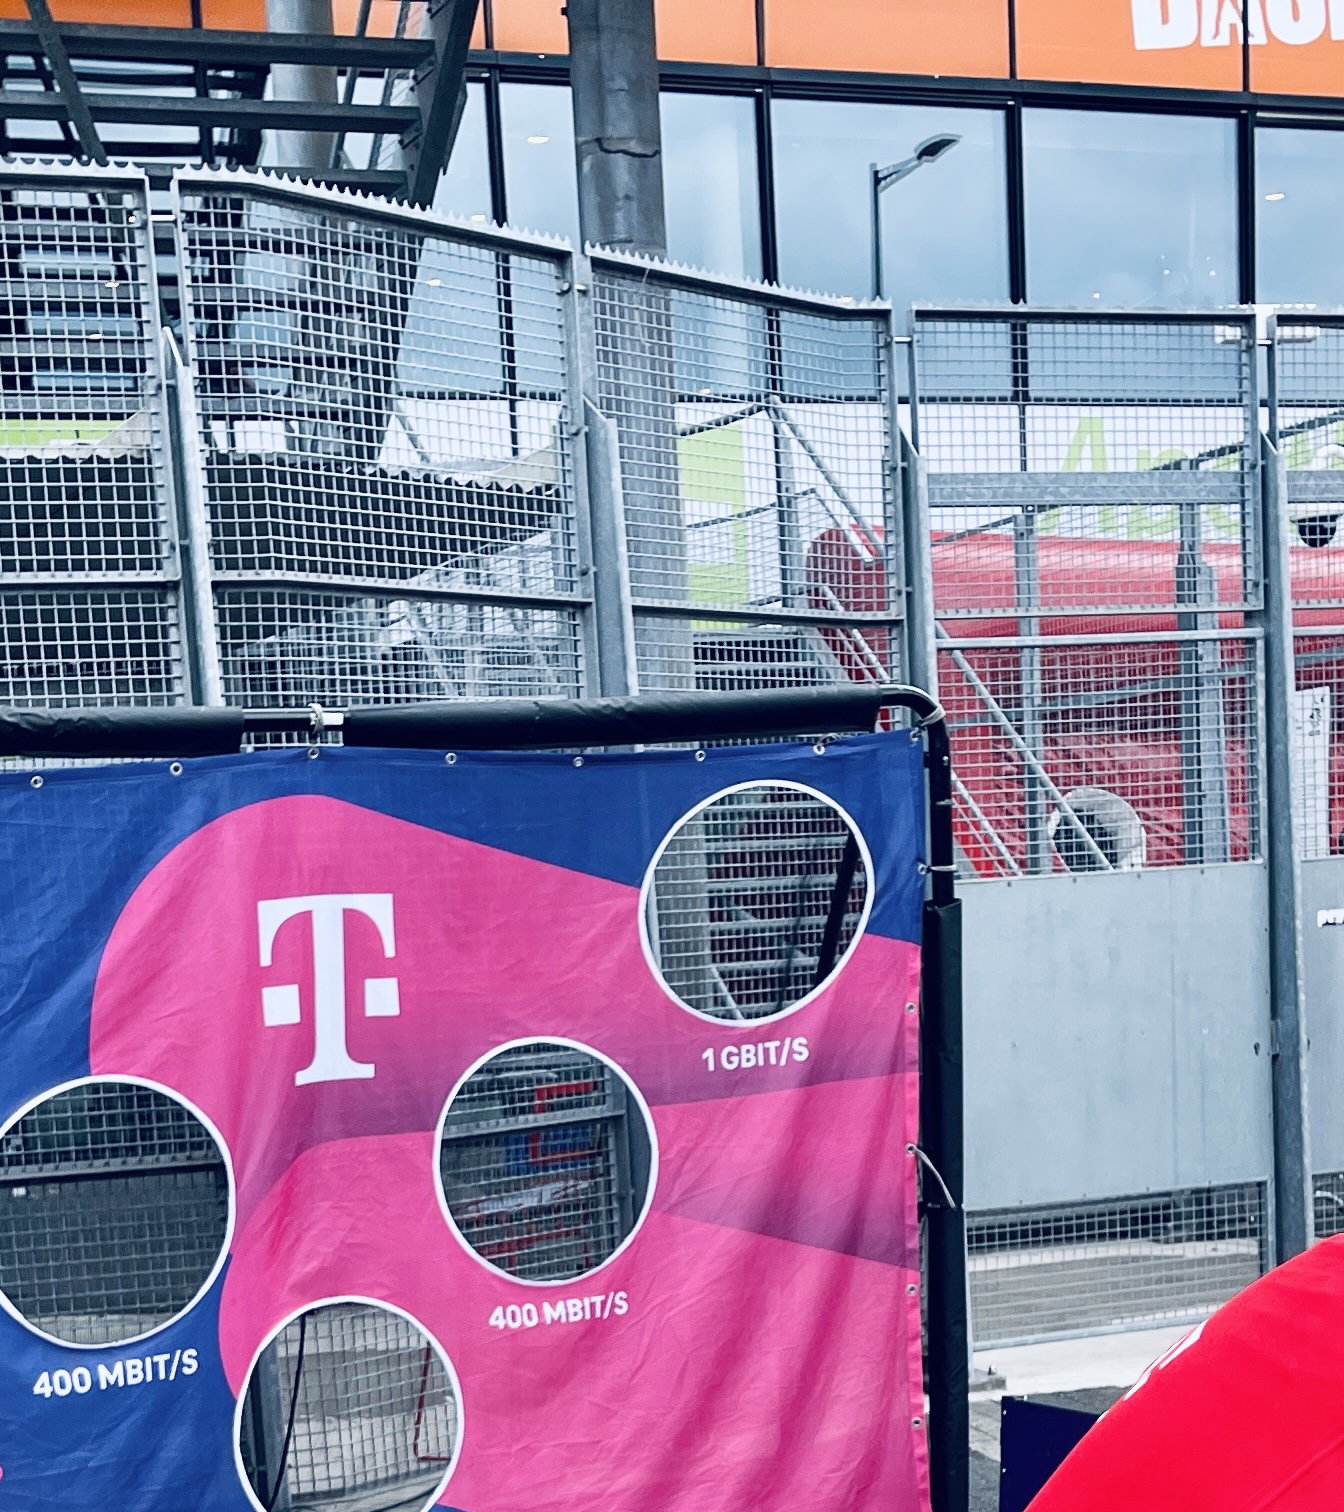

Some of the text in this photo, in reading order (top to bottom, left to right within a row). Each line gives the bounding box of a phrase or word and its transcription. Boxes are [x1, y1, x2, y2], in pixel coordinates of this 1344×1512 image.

[701, 1036, 810, 1072] 1 GBIT/S
[488, 1290, 629, 1330] 400 MBIT/S
[32, 1348, 199, 1399] 400 MBIT/S
